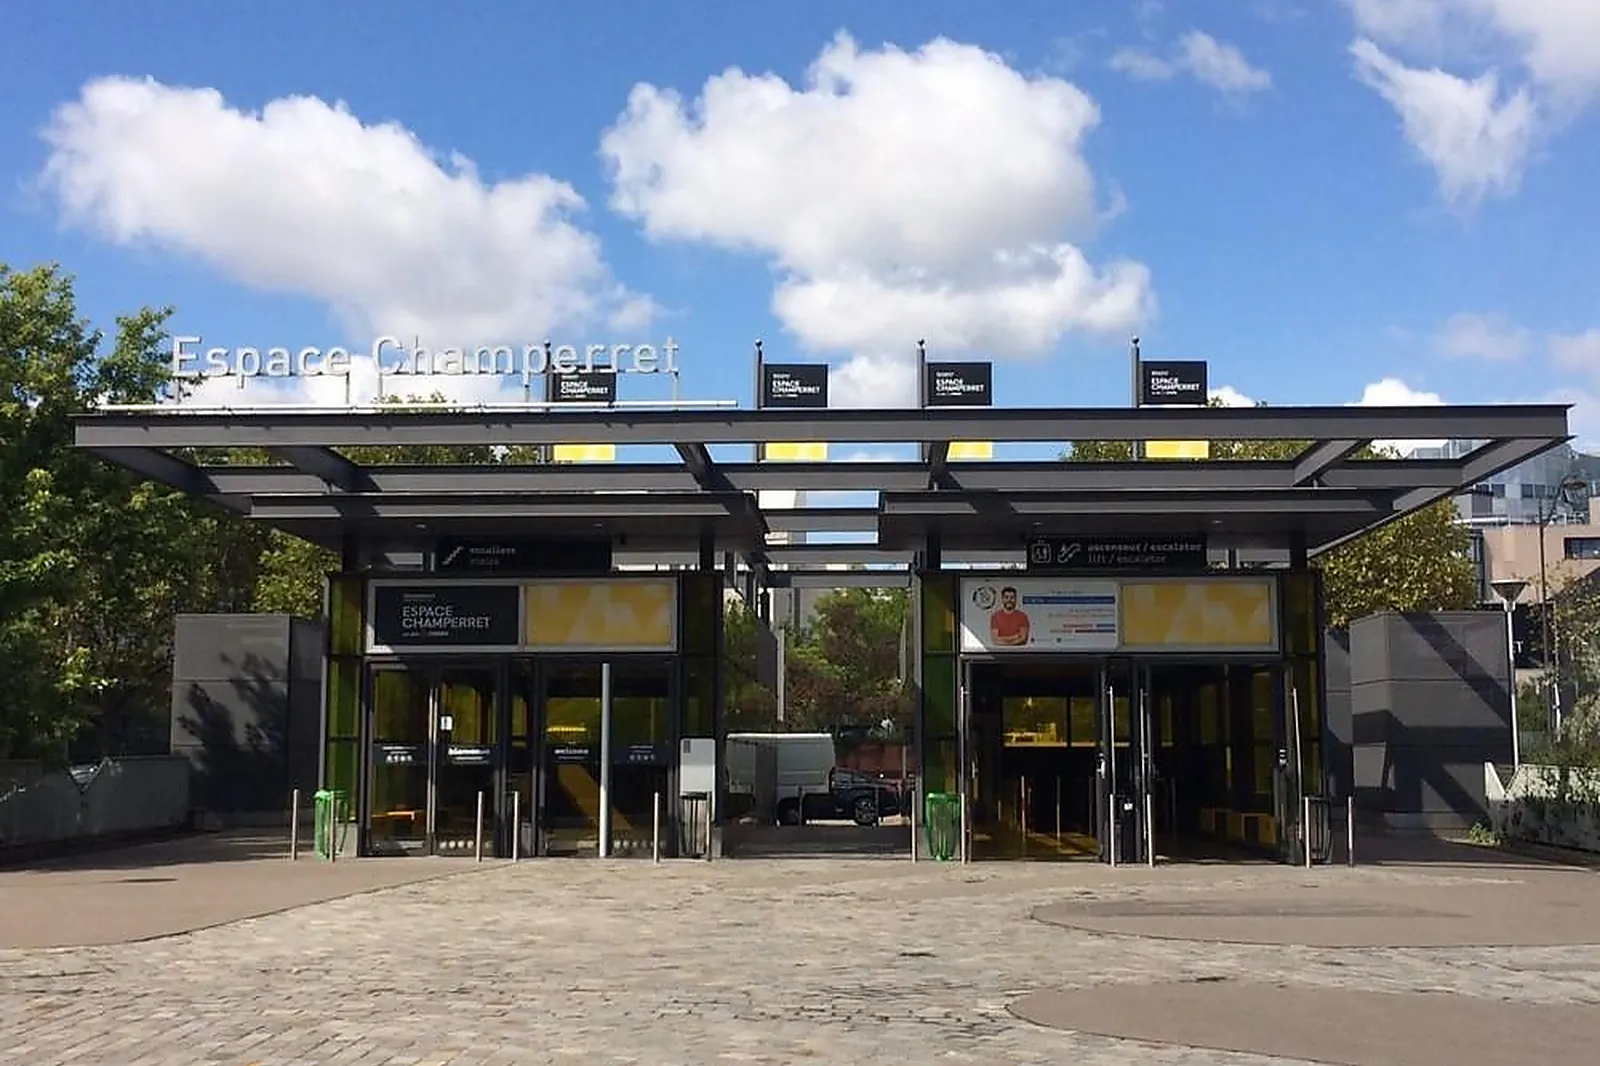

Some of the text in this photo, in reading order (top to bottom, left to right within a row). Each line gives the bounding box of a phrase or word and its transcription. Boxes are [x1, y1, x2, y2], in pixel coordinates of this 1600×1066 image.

[173, 335, 679, 389] Espace Champerret
[402, 605, 454, 618] ESPACE
[402, 616, 491, 629] CHAMPERRET
